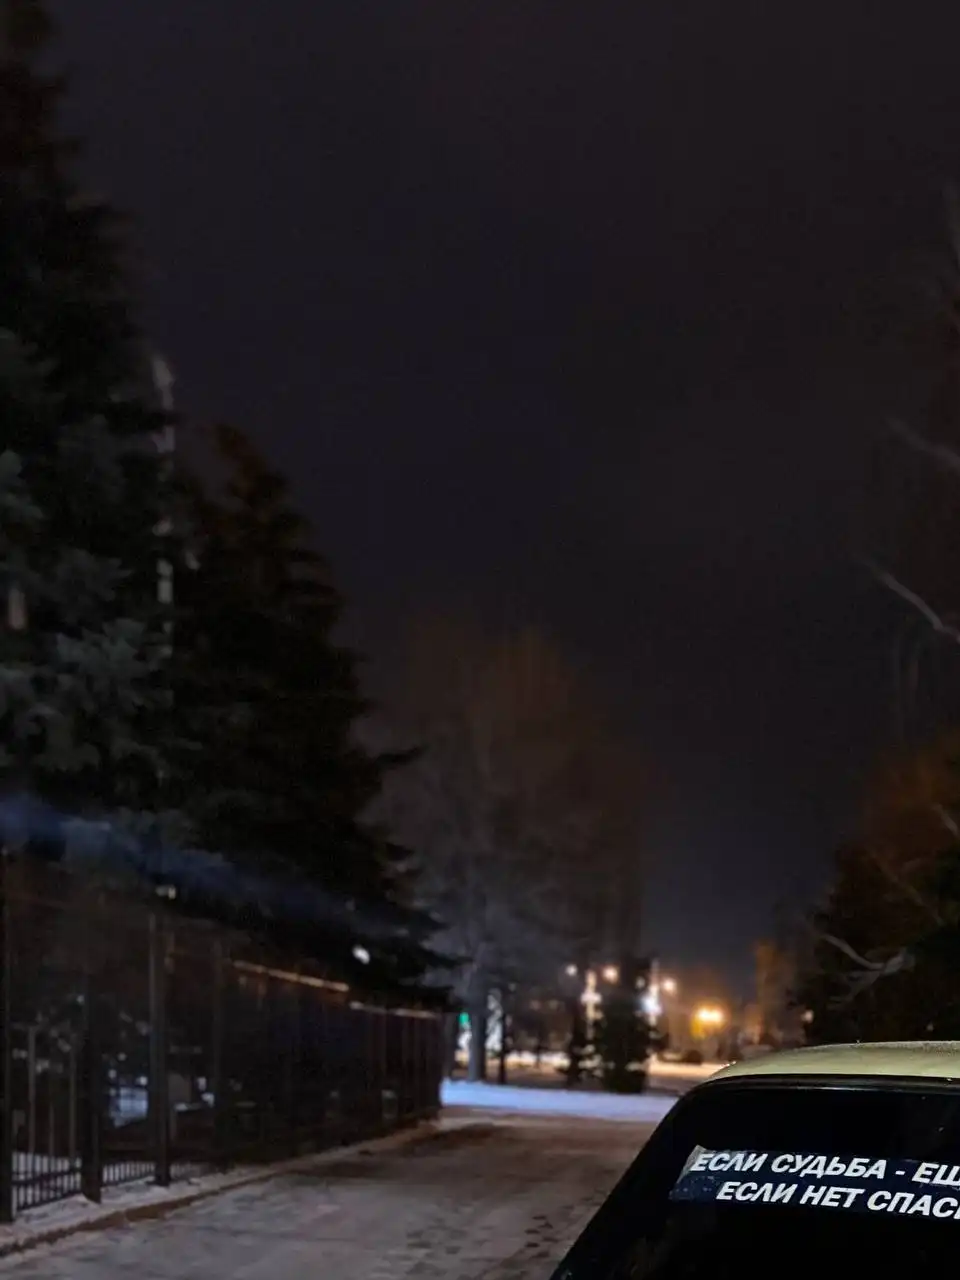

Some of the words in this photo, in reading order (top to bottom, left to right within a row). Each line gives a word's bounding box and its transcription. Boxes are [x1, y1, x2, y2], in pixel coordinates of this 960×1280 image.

[690, 1153, 768, 1172] ЕСЛИ
[771, 1154, 887, 1180] СУДЬБА
[716, 1182, 797, 1204] ЕСЛИ
[799, 1186, 863, 1208] НЕТ
